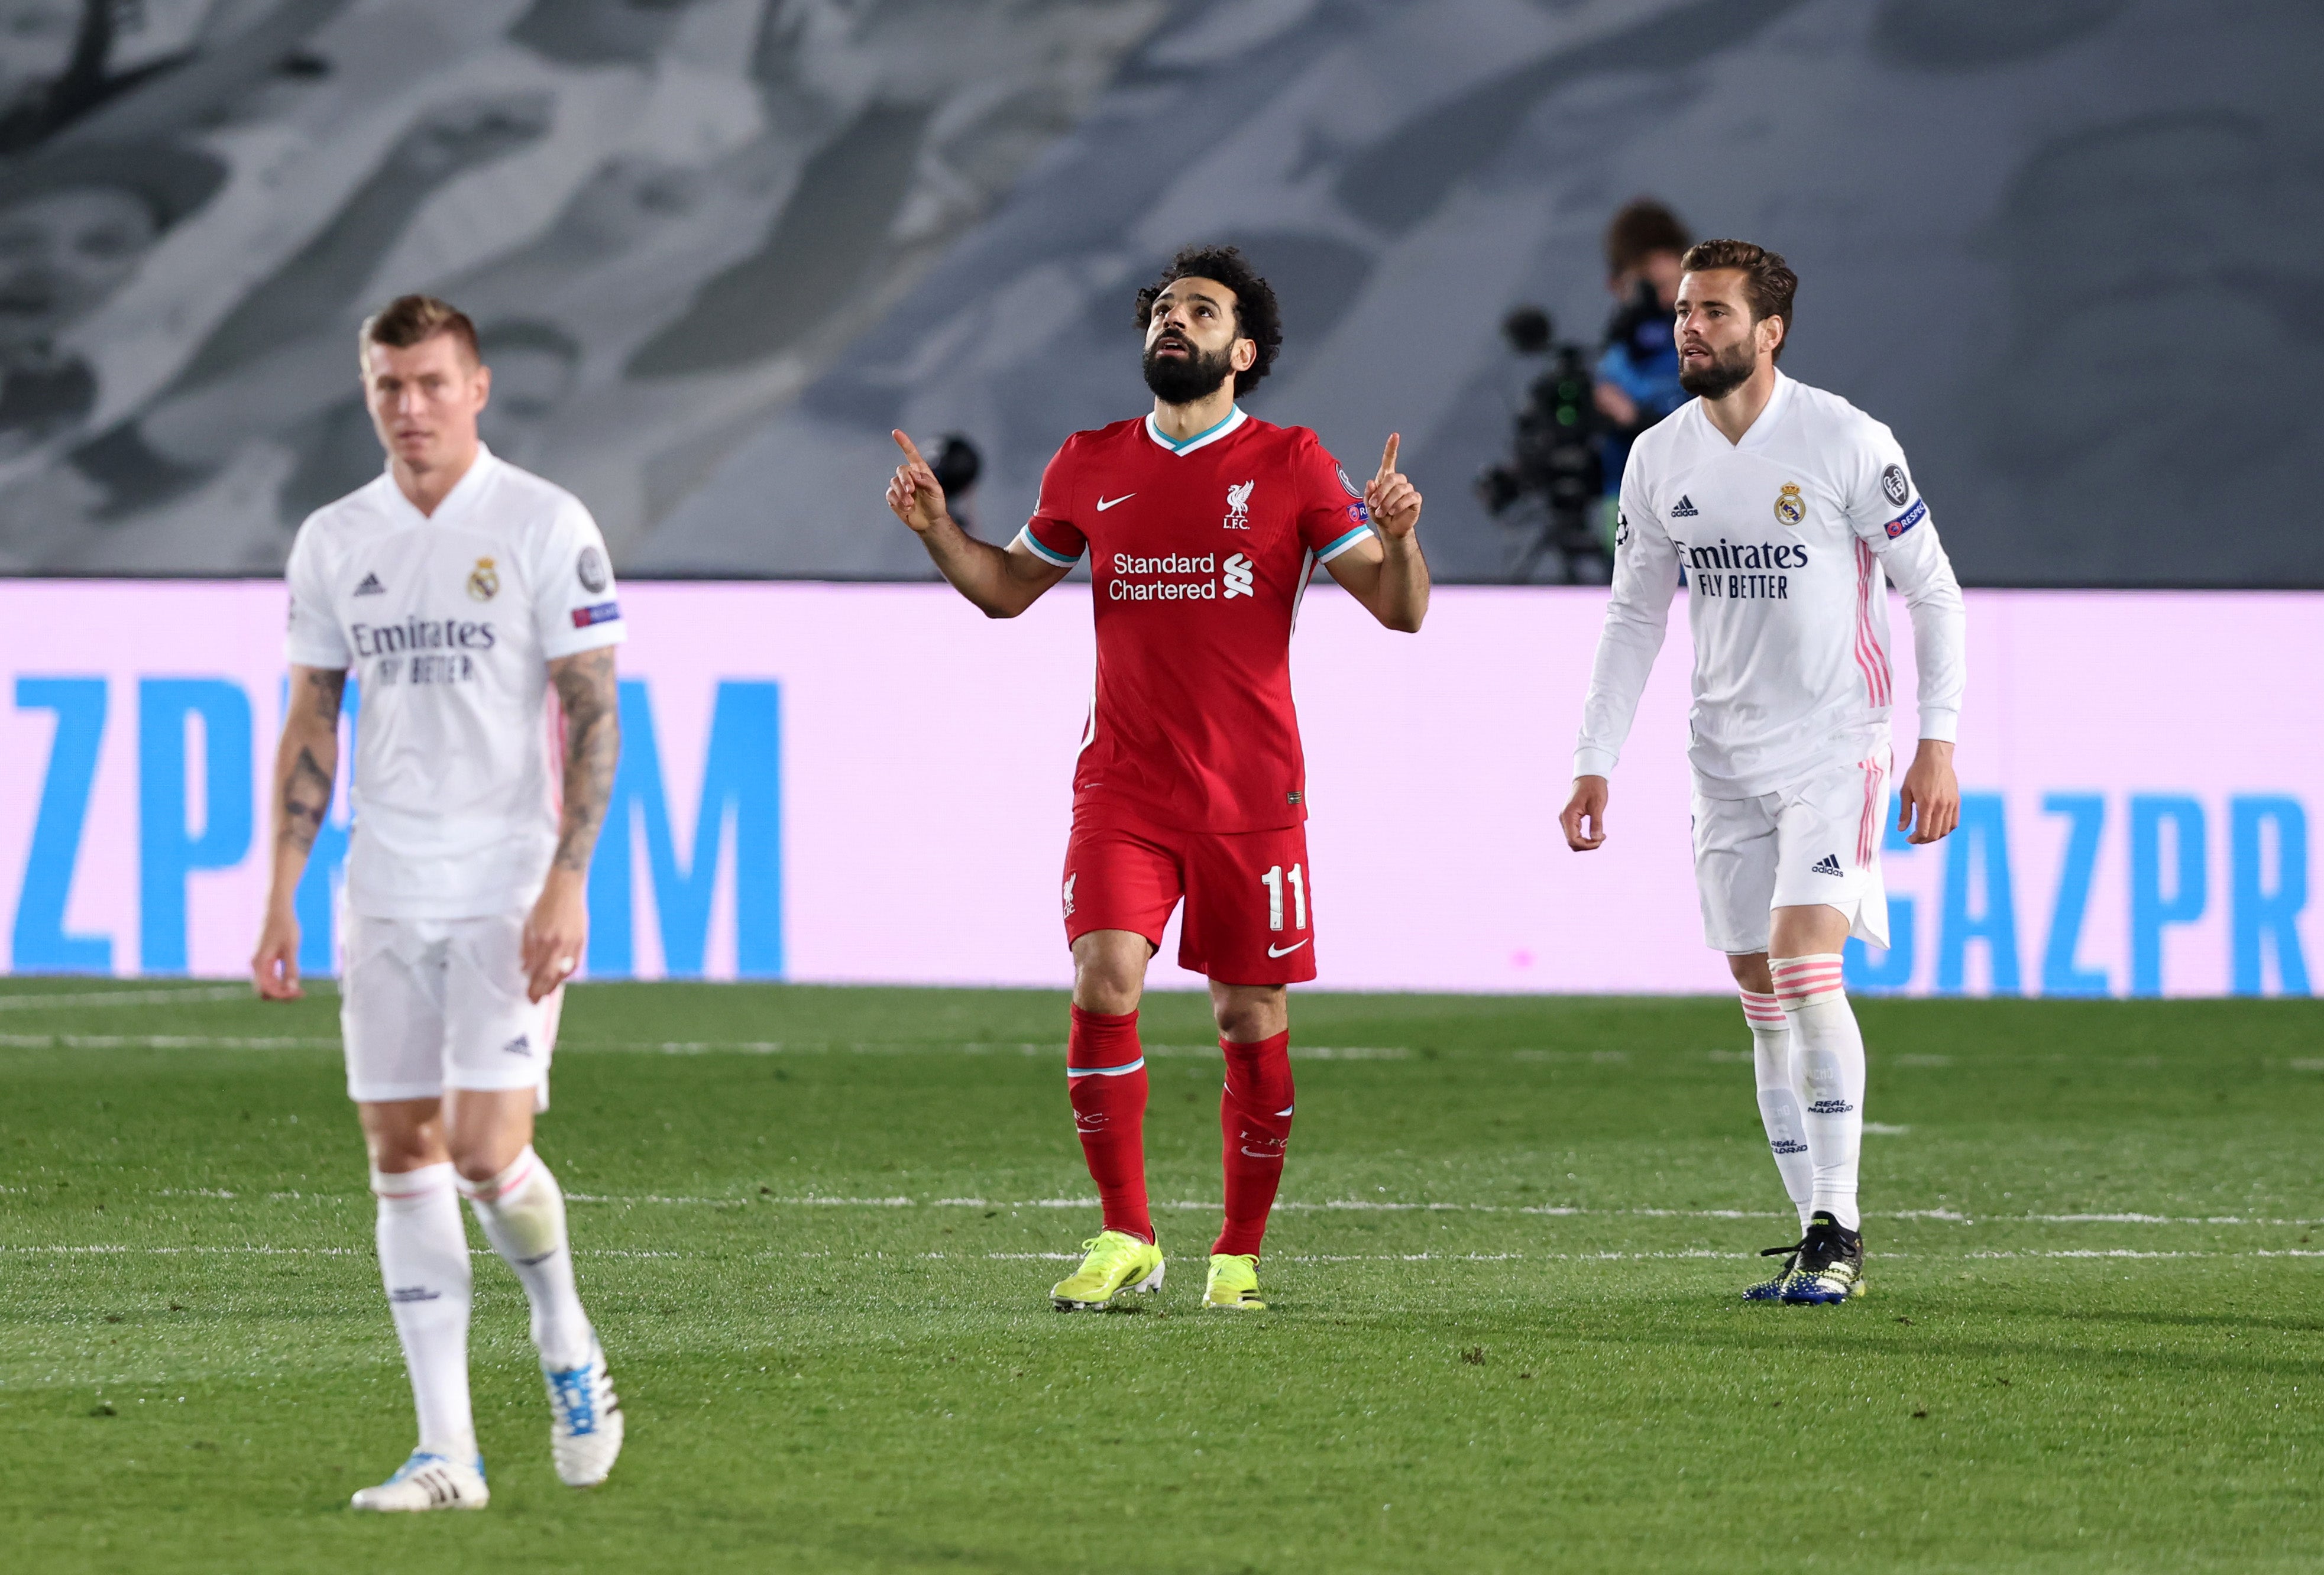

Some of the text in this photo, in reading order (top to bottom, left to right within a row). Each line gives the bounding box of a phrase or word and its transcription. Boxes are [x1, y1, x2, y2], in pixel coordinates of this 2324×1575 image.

[1671, 509, 1698, 517] adidas
[1114, 552, 1215, 574] Standard
[1674, 538, 1808, 569] Emirates
[1109, 579, 1216, 600] Chartered
[1698, 574, 1788, 599] FLY BETTER
[1811, 866, 1844, 877] adidas
[1261, 863, 1306, 931] 11
[1808, 1104, 1853, 1114] MADRID
[1772, 1145, 1808, 1154] ADRID
